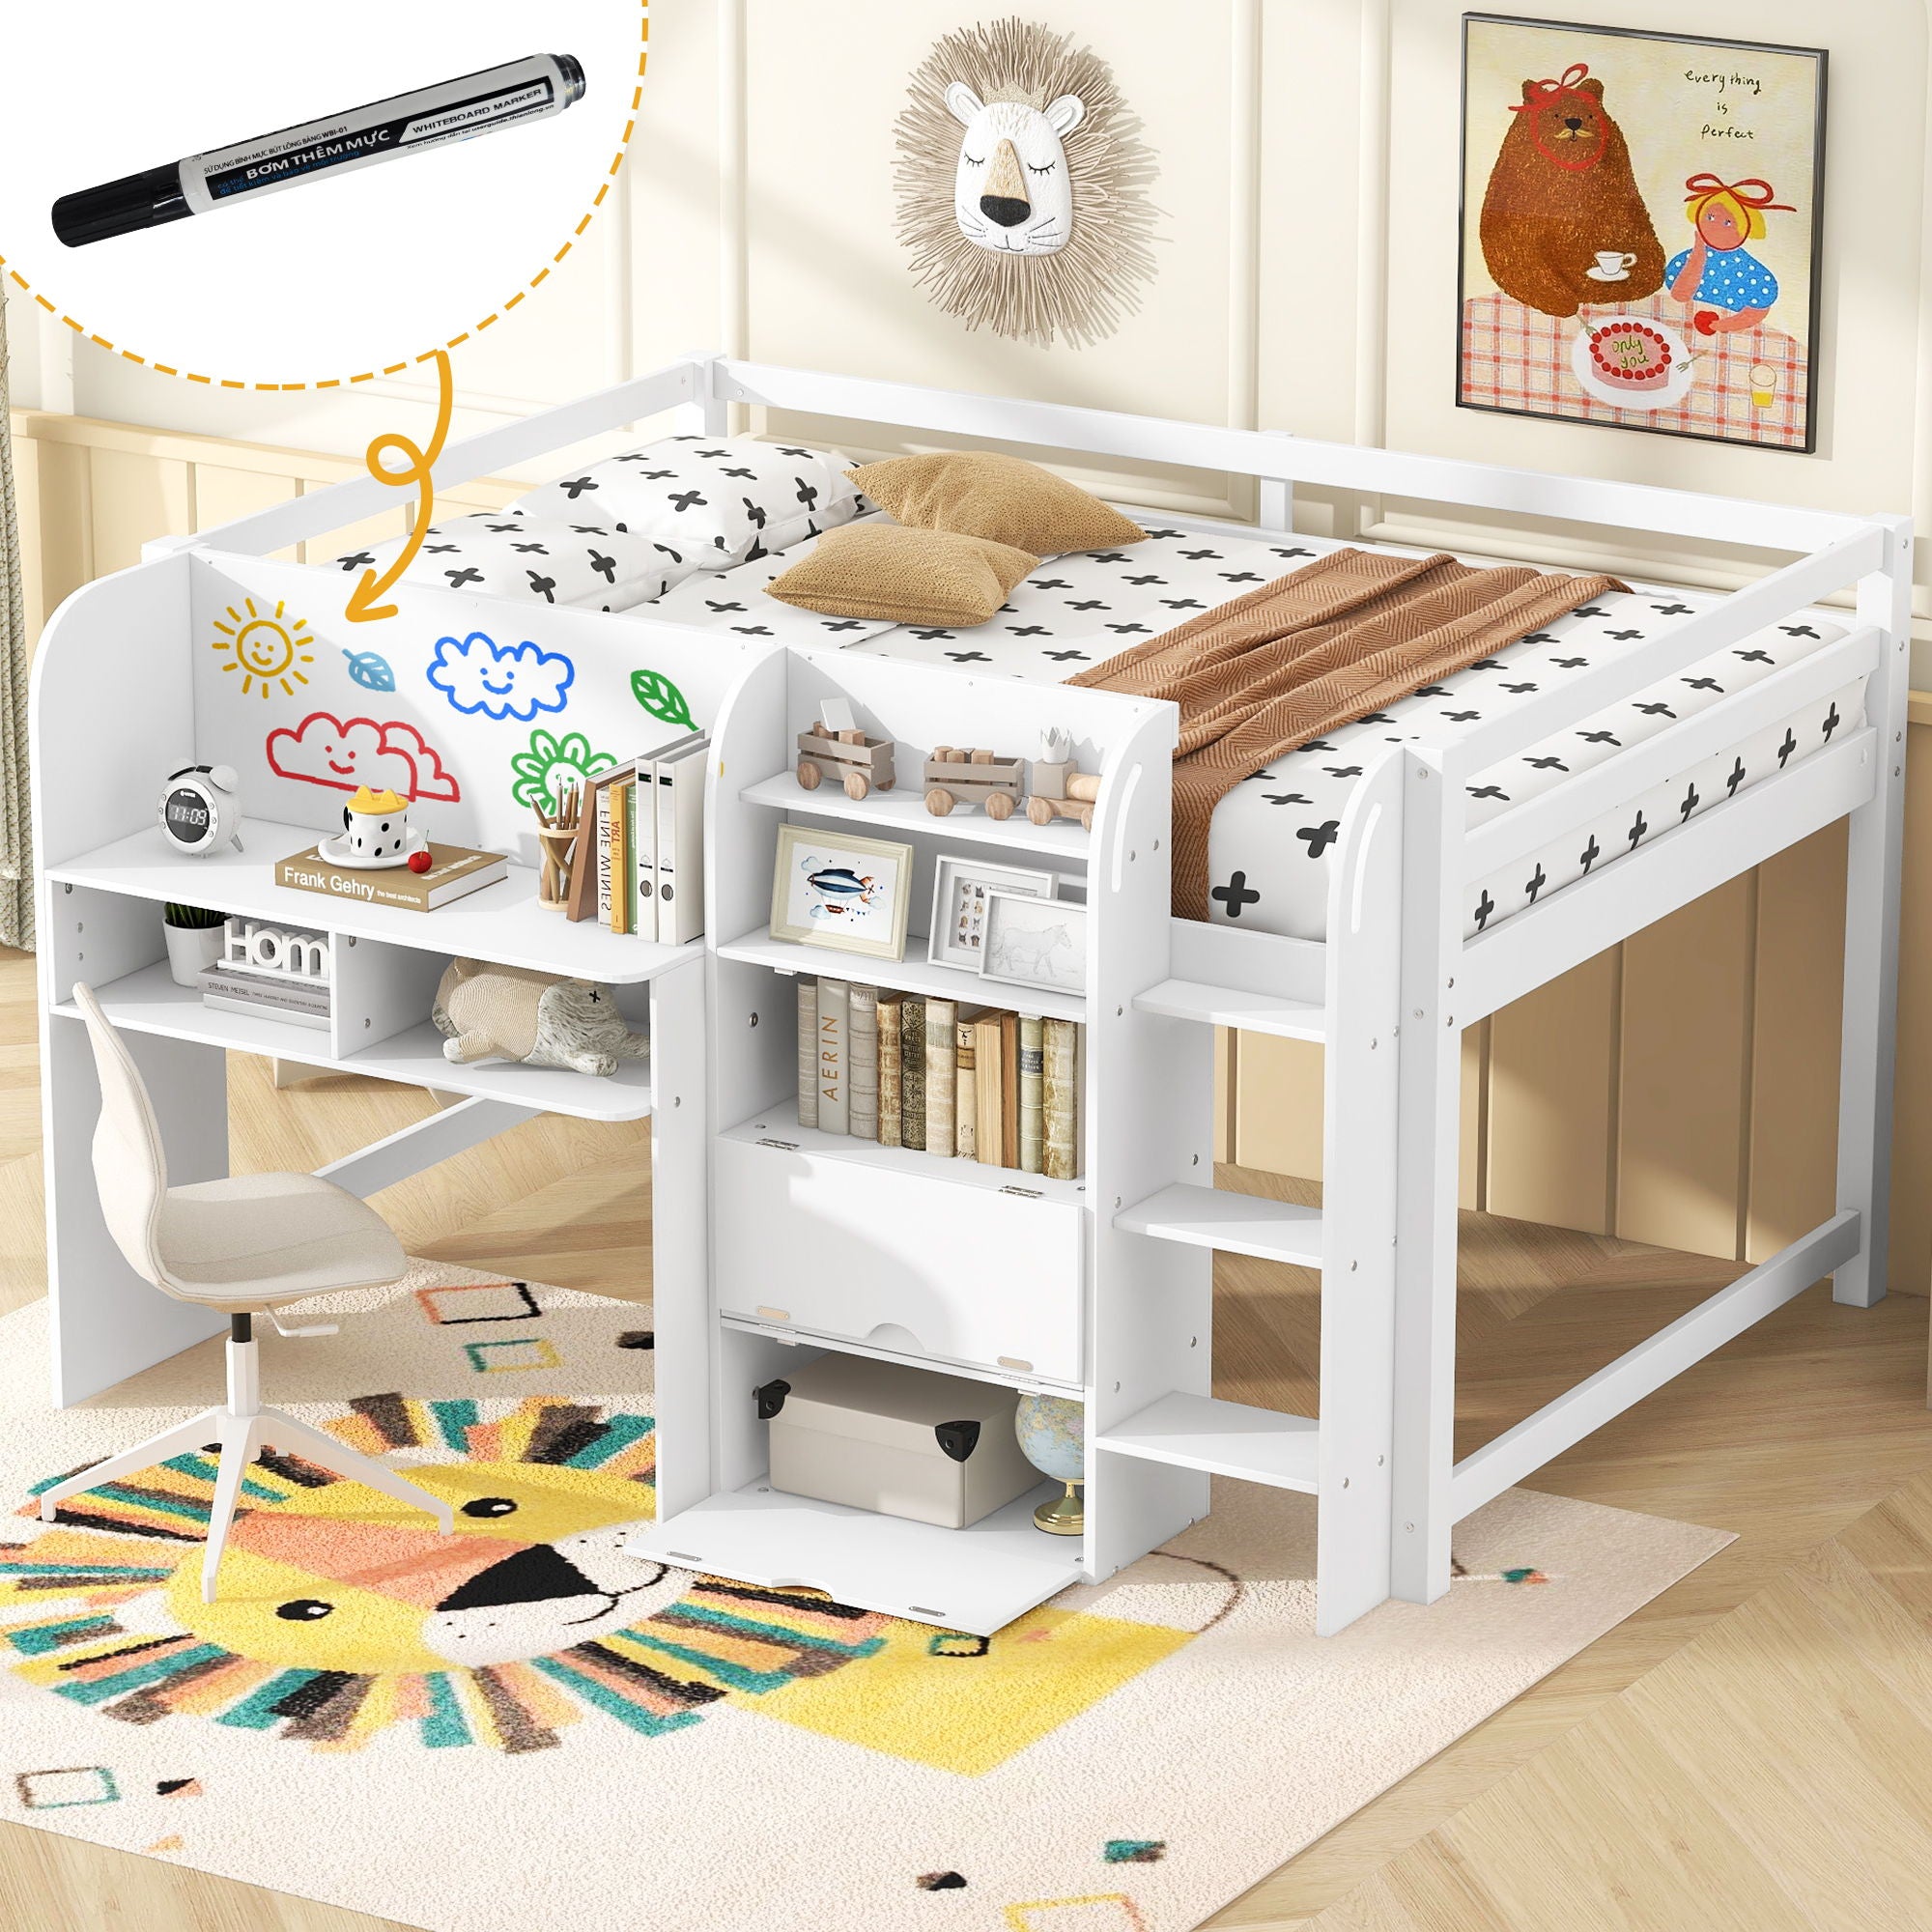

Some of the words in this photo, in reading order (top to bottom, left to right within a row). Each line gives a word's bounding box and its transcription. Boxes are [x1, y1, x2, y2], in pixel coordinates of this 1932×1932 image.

[412, 106, 491, 133] WHITEBOARD
[494, 88, 542, 111] MARKER
[1717, 101, 1728, 115] is
[213, 158, 235, 171] DỤNG
[269, 144, 282, 155] BÚT
[321, 126, 348, 139] WBI-01
[245, 158, 290, 180] BƠM
[291, 144, 344, 165] THÊM
[345, 129, 390, 151] MỰC
[1611, 334, 1643, 355] only
[1621, 355, 1649, 368] you
[174, 806, 207, 825] 11:09
[284, 866, 327, 889] Frank
[329, 875, 375, 901] Gehry
[208, 981, 229, 992] STEVEN
[821, 1015, 838, 1102] AERIN
